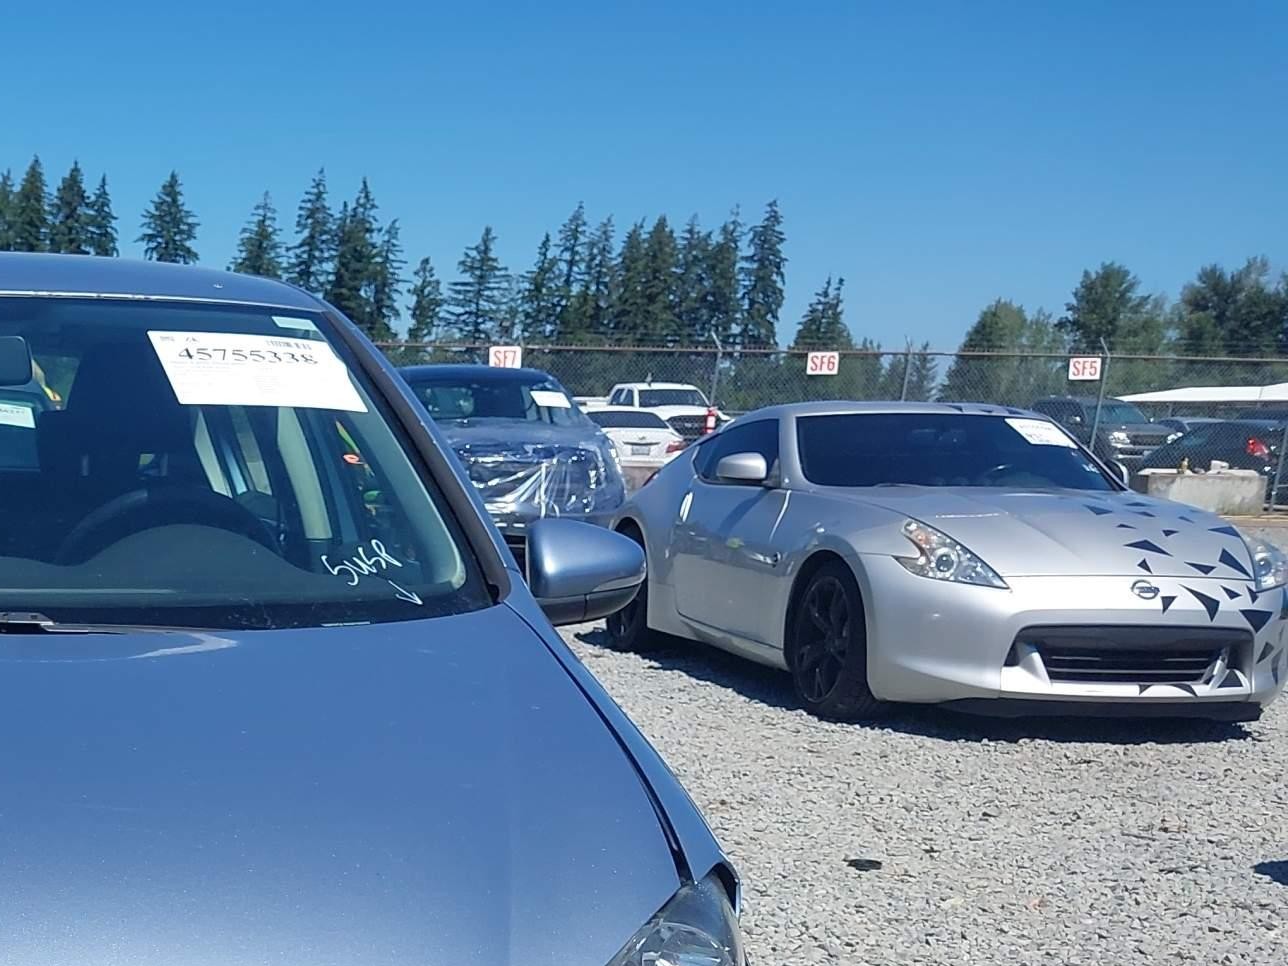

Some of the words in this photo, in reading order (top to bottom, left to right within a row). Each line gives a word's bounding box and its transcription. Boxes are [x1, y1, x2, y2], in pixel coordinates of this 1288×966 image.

[178, 347, 318, 365] 45755338
[494, 350, 517, 368] SF7
[810, 355, 836, 371] SF6
[1072, 360, 1097, 377] SF5
